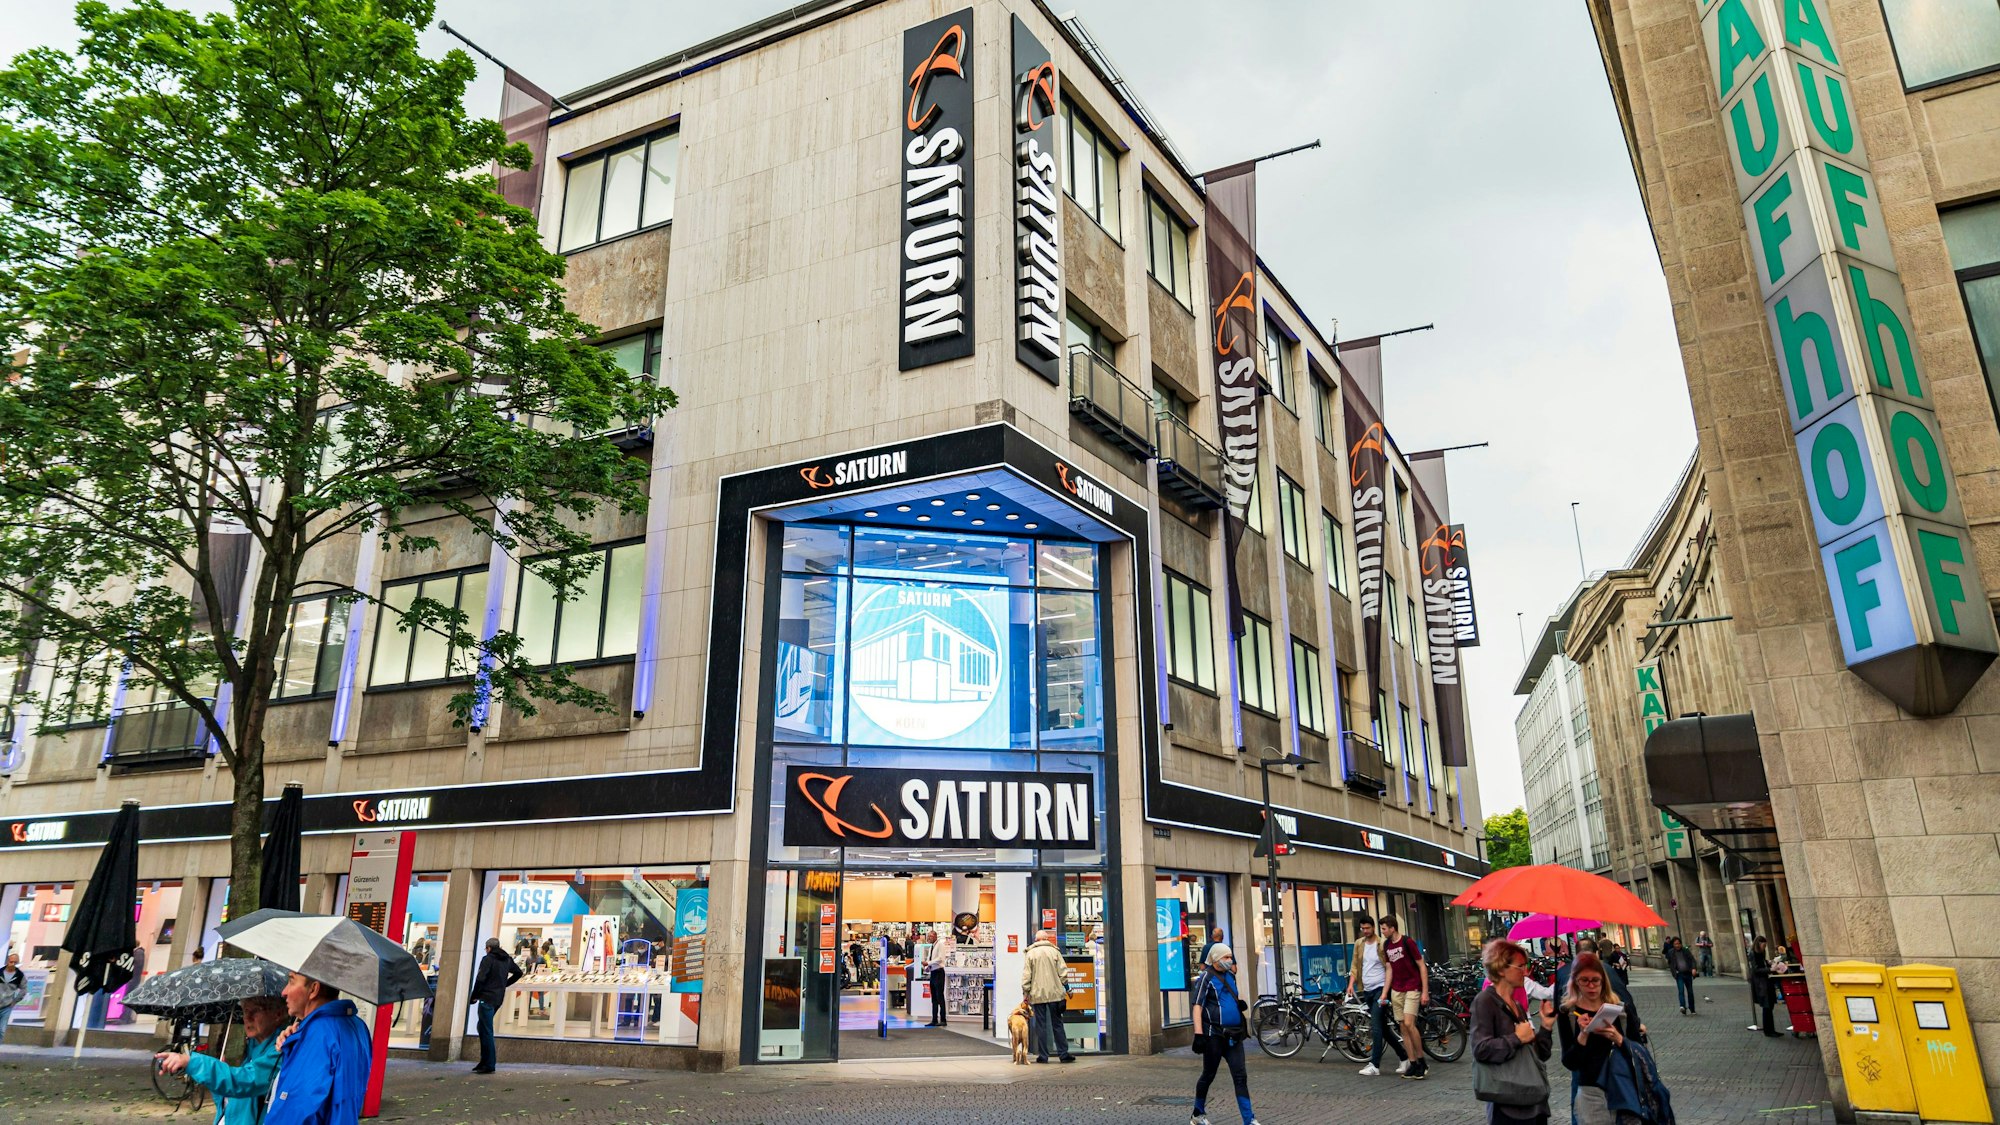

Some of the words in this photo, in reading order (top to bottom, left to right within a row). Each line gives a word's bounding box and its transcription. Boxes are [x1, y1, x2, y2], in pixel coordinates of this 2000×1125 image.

[905, 126, 964, 344] SATURN
[1015, 138, 1061, 359] SATURN
[1703, 0, 1881, 652] AUFhOF
[834, 450, 907, 484] SATURN
[1076, 475, 1113, 516] SATURN
[898, 590, 951, 607] SATURN
[1422, 578, 1458, 686] SATURN
[376, 797, 431, 823] SATURN
[899, 778, 1090, 842] SATURN
